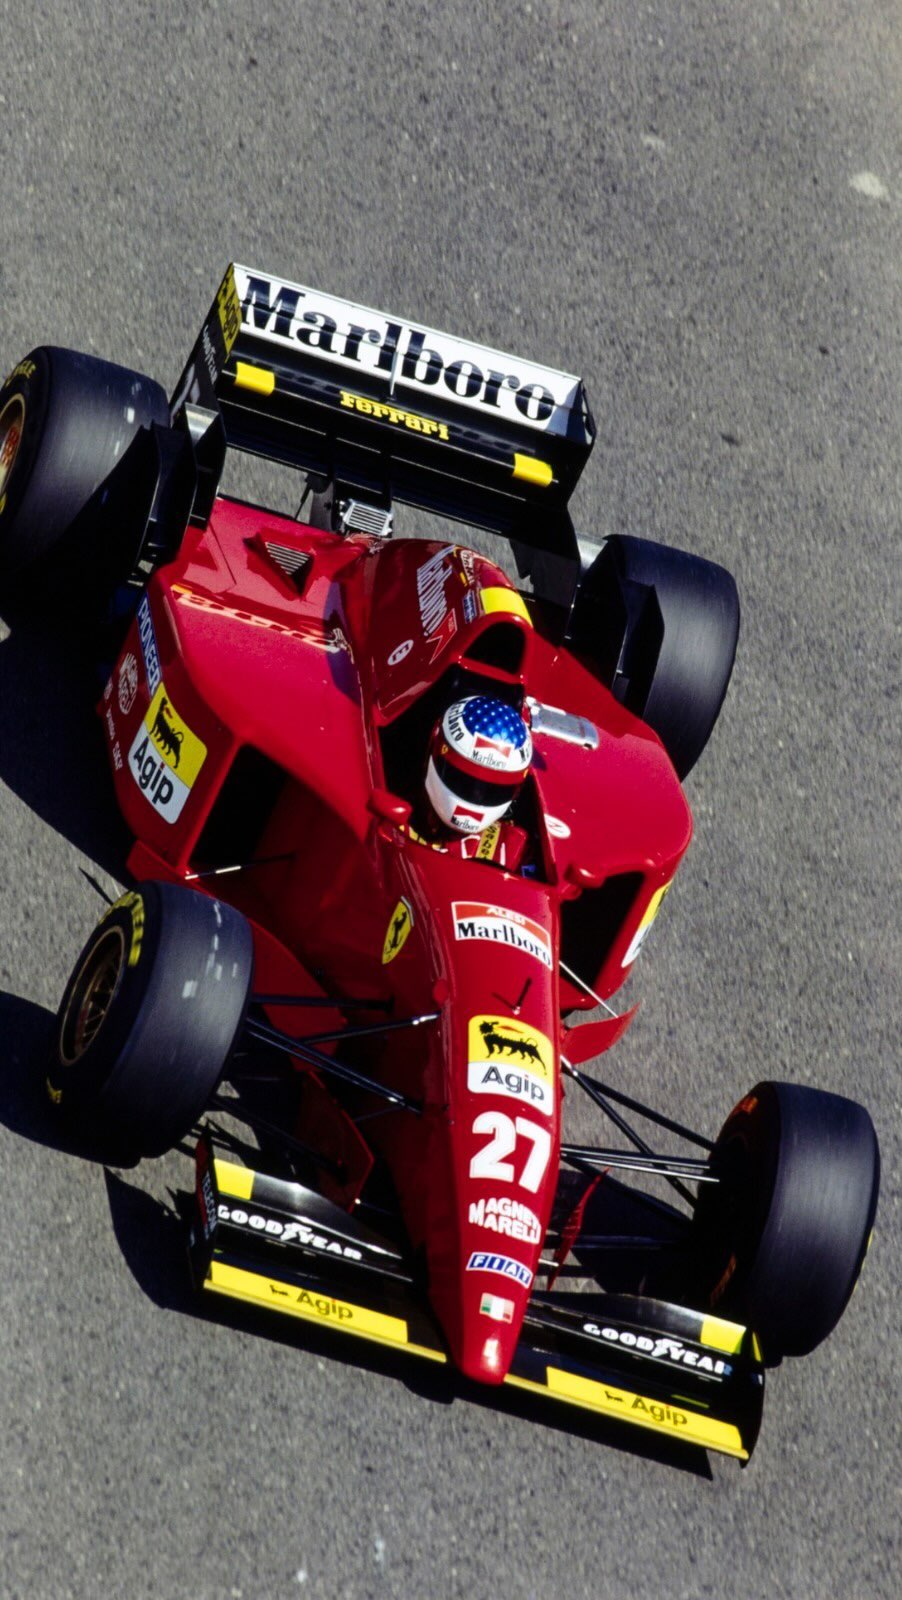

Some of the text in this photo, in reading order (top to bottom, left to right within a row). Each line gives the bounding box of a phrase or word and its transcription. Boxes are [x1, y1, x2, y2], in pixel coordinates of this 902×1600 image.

[241, 275, 555, 421] Marlboro
[340, 390, 450, 440] Ferrari
[138, 597, 161, 697] PIONEER
[133, 736, 174, 805] Agip
[457, 922, 551, 966] Marlboro
[481, 1066, 545, 1101] Agip
[469, 1111, 551, 1194] 27
[218, 1205, 362, 1260] GOODYEAR
[471, 1253, 532, 1286] FIAT
[296, 1290, 353, 1320] Agip
[583, 1323, 734, 1375] GOODYEAR
[631, 1397, 688, 1426] Agip
